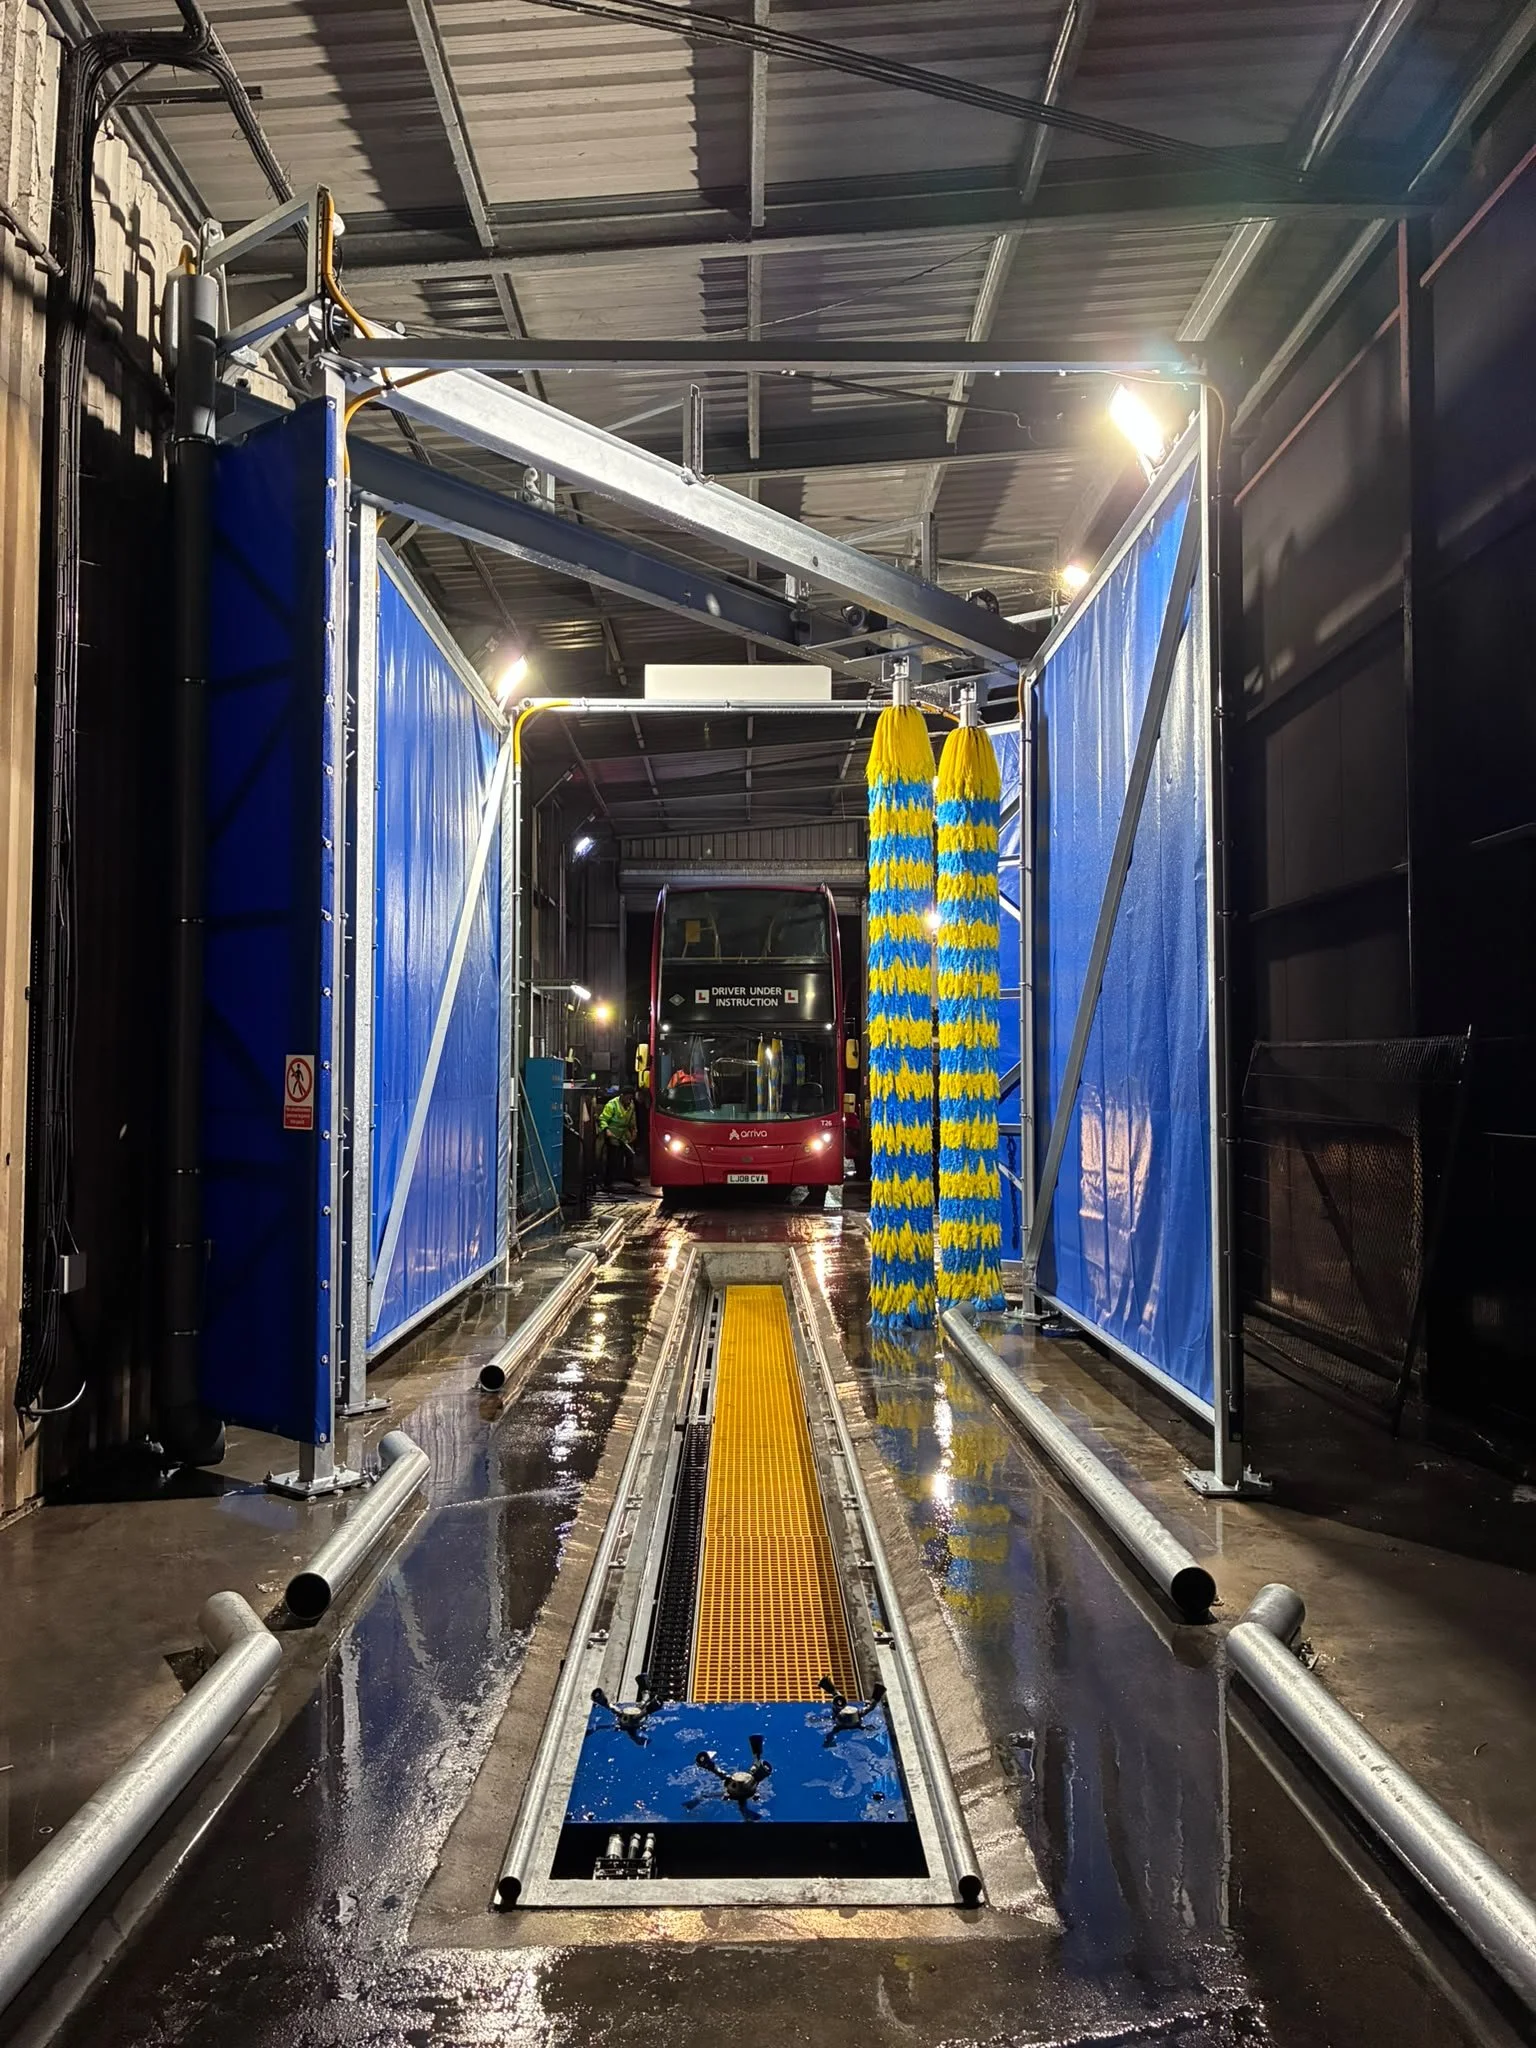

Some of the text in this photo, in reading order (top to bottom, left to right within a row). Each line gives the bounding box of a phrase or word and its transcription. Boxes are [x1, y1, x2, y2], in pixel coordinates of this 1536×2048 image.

[711, 986, 782, 995] DRIVER UNDER
[698, 992, 706, 1001] L
[787, 992, 795, 1001] L
[715, 998, 778, 1006] INSTRUCTION
[750, 1175, 765, 1183] CVA
